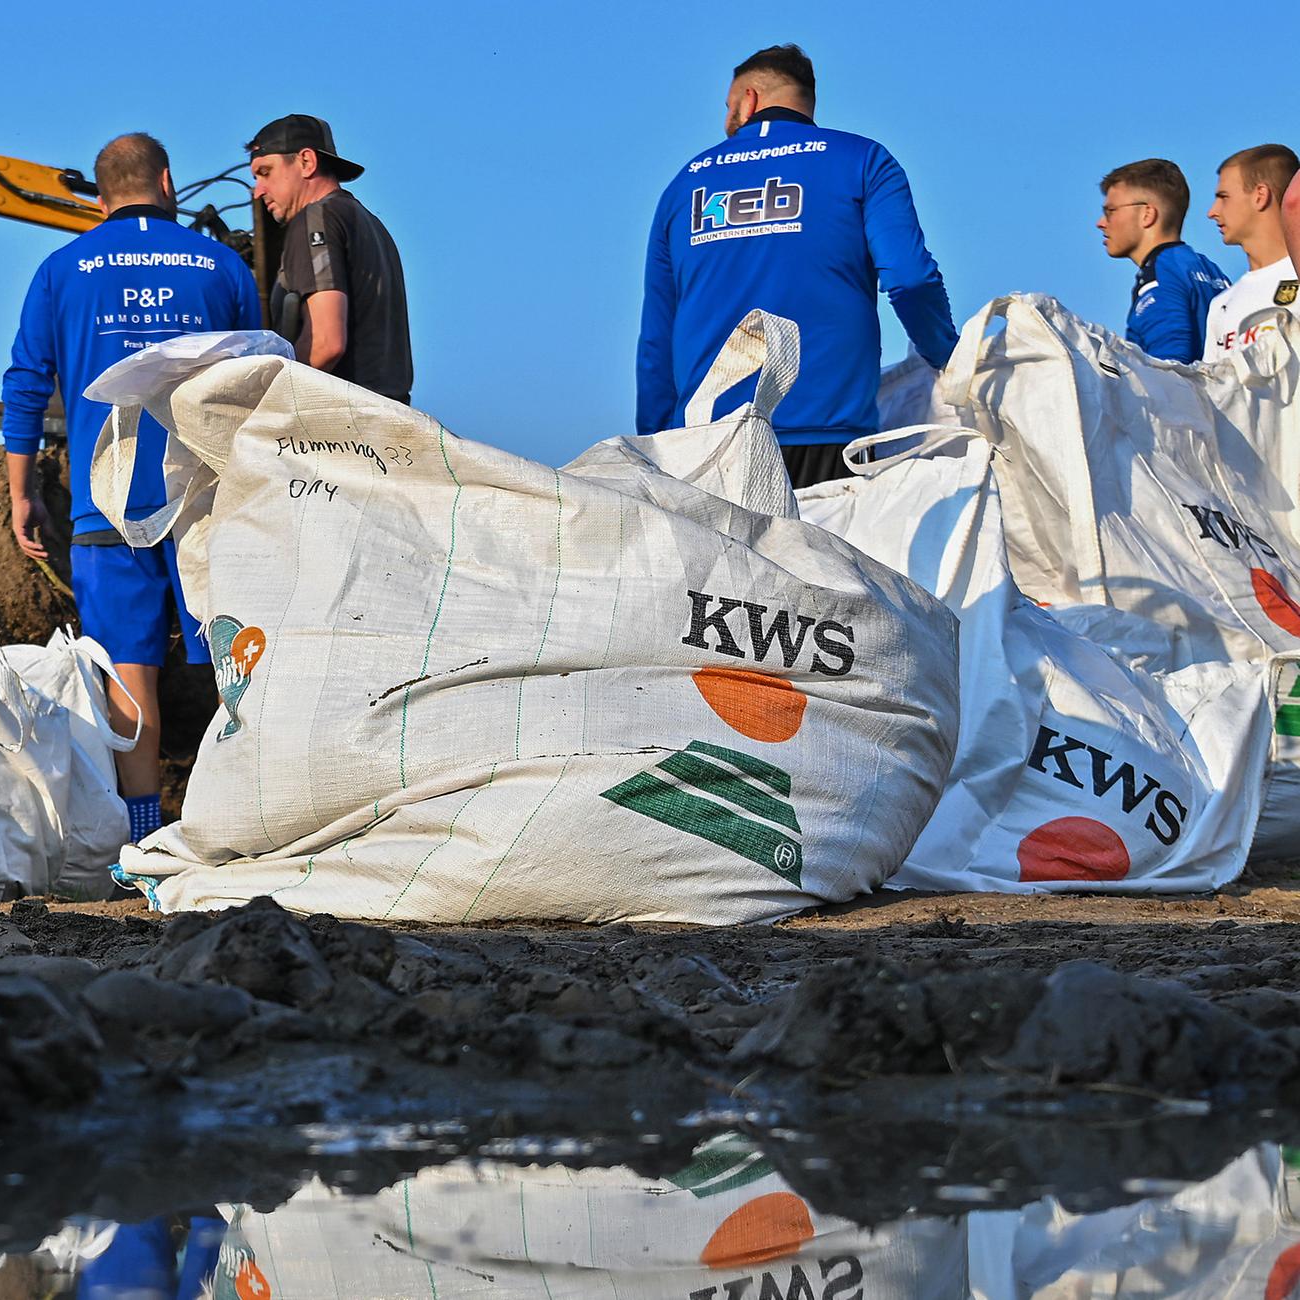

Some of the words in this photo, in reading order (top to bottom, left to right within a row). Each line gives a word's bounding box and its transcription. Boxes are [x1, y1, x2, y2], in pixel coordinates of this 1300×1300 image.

[688, 156, 712, 173] SpG
[715, 140, 828, 166] LEBUS/PODELZIG
[691, 226, 771, 244] BAUUNTERNEHMEN
[772, 224, 800, 233] GmbH
[78, 255, 105, 274] SpG
[108, 252, 216, 271] LEBUS/PODELZIG
[123, 287, 174, 308] P&P
[96, 313, 202, 325] IMMOBILIEN
[276, 436, 388, 475] Flemming
[681, 589, 855, 677] KWS
[1027, 725, 1188, 846] KWS
